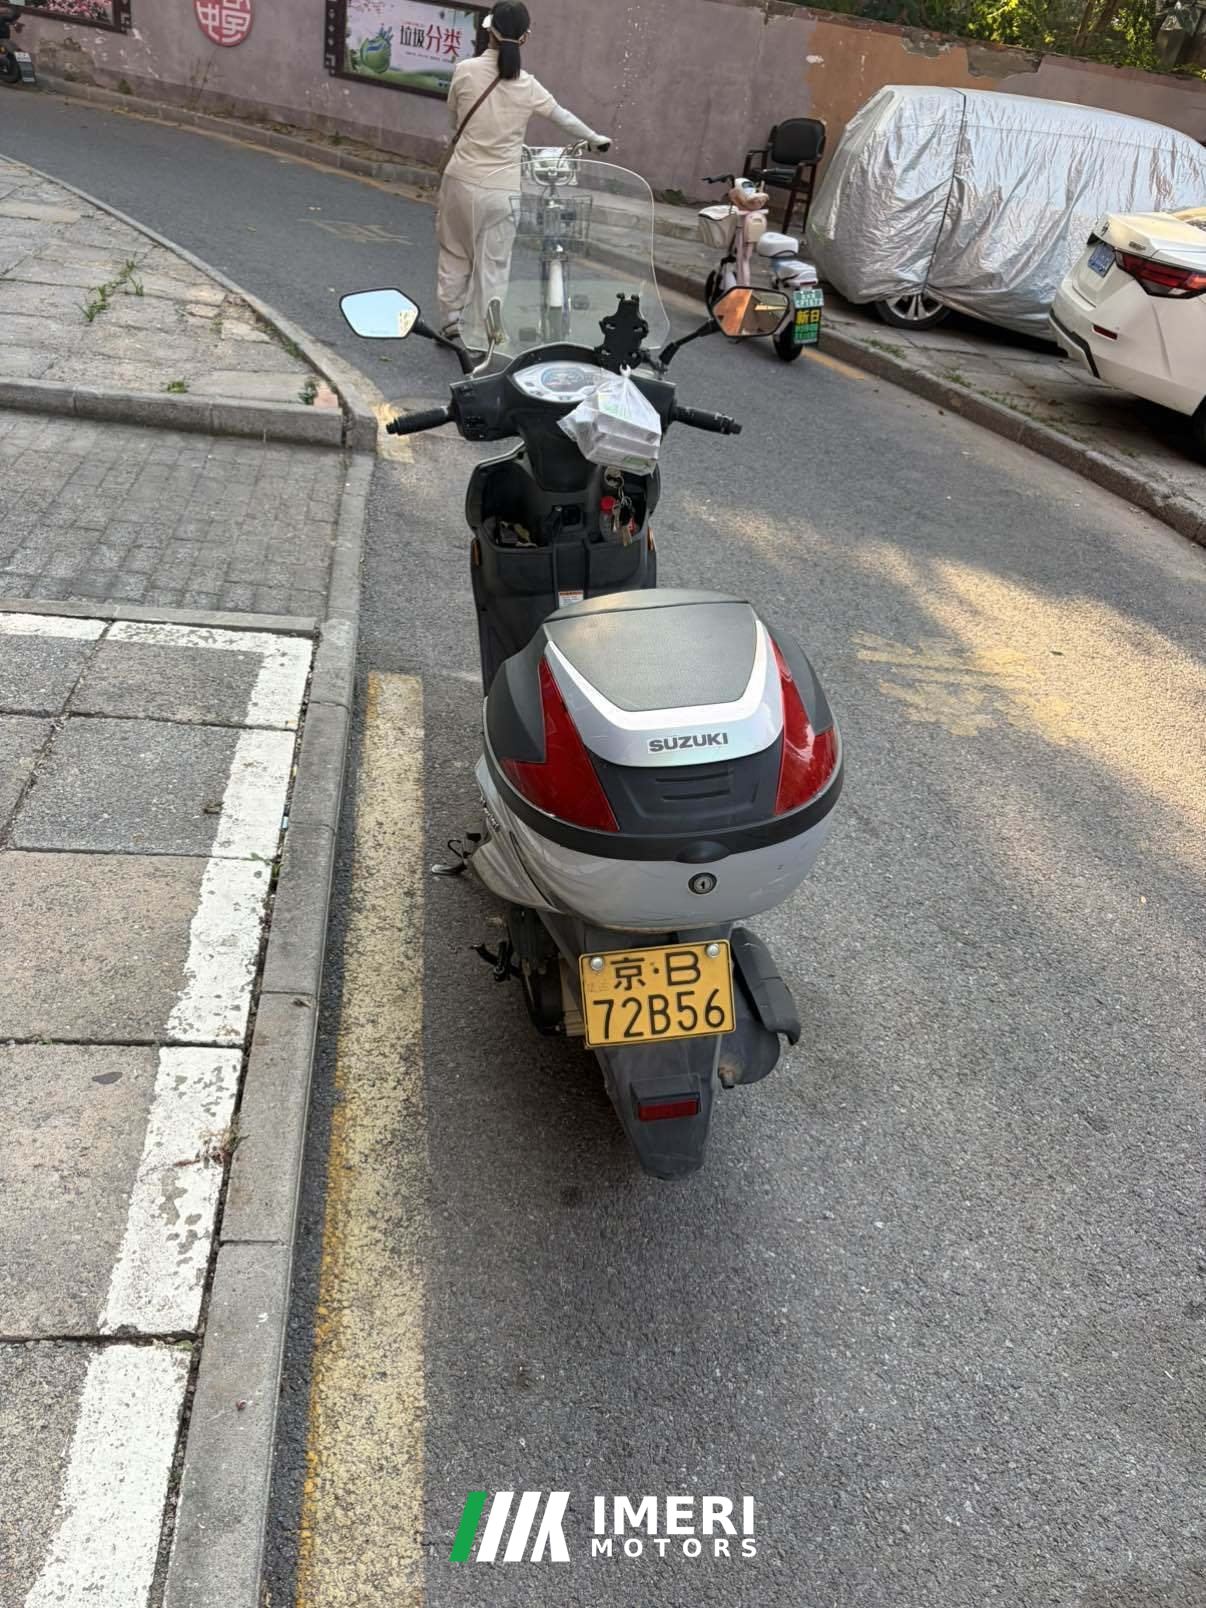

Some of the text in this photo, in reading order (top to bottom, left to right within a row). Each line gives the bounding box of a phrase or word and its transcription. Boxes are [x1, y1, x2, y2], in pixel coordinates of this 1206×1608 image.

[400, 24, 461, 57] 垃圾分类
[648, 732, 729, 753] SUZUKI
[593, 988, 725, 1040] 72B56
